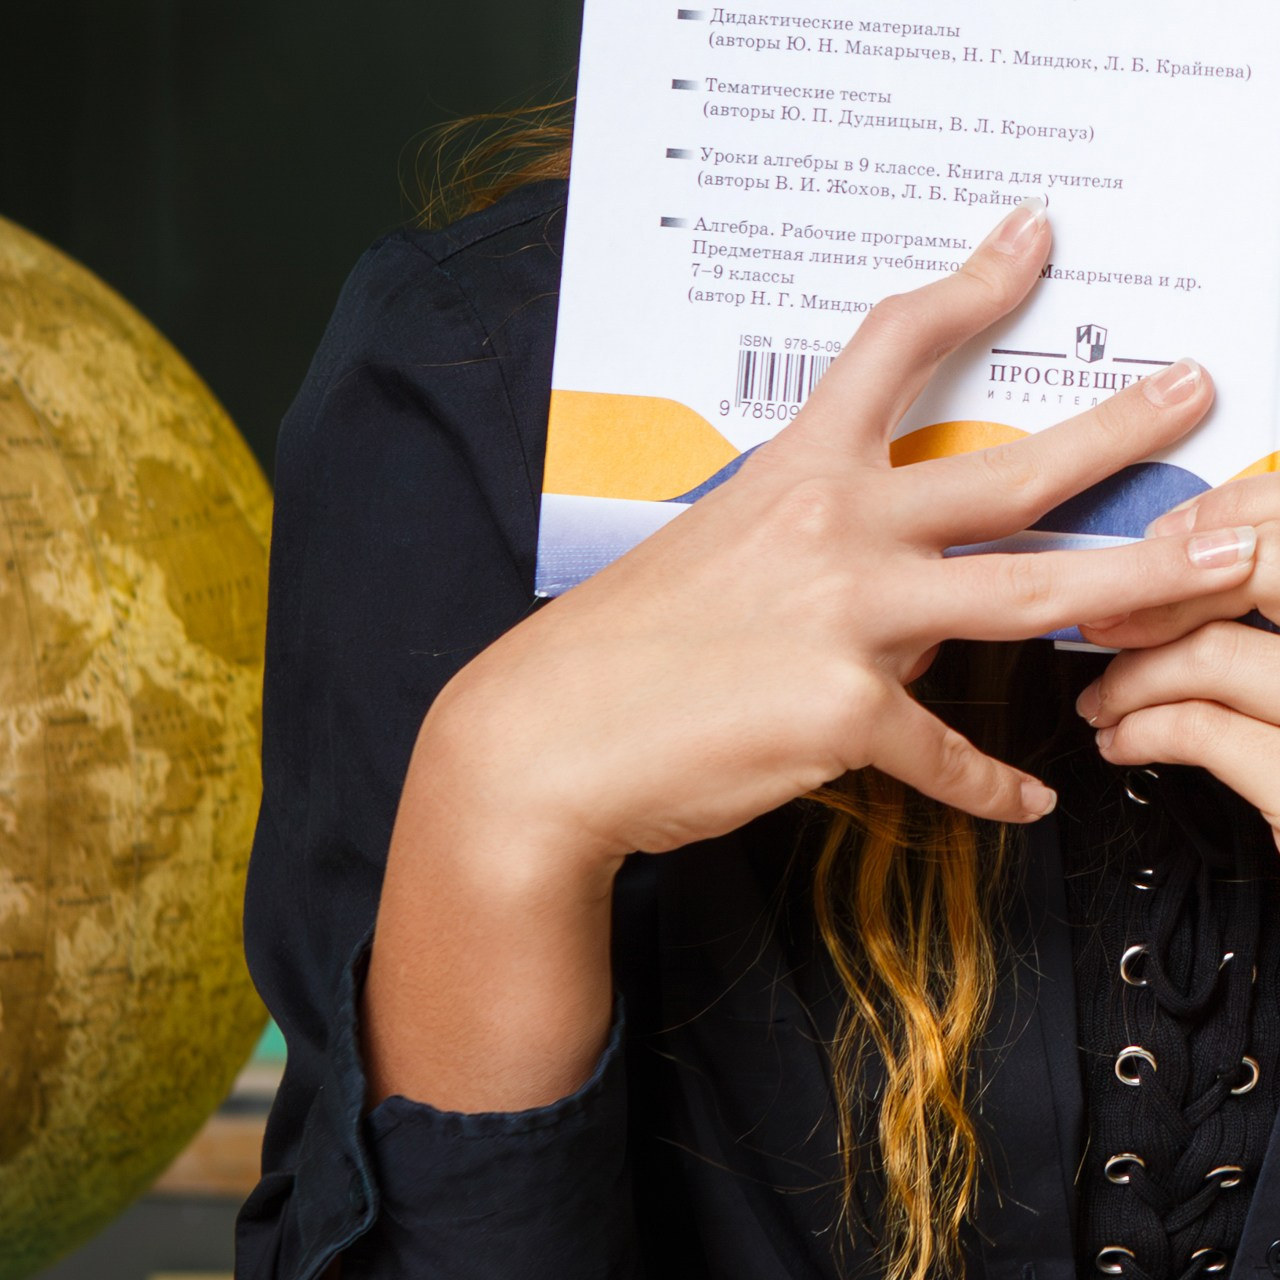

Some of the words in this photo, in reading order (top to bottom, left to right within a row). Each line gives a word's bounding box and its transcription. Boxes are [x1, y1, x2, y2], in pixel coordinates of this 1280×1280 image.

[709, 7, 854, 31] Дидактические
[858, 21, 961, 38] материалы
[708, 31, 781, 52] (авторы
[785, 35, 812, 52] Ю.
[817, 37, 839, 54] Н.
[844, 39, 957, 63] Макарычев,
[962, 46, 984, 63] Н.
[989, 48, 1007, 64] Г.
[1012, 49, 1098, 72] Миндюк,
[1103, 55, 1125, 72] Л.
[1130, 57, 1150, 73] Б.
[1156, 58, 1252, 82] Крайнева)
[704, 76, 835, 100] Тематические
[839, 90, 892, 104] тесты
[702, 100, 776, 122] (авторы
[780, 105, 806, 122] Ю.
[811, 107, 833, 124] П.
[837, 109, 943, 133] Дудницын,
[949, 116, 968, 132] В.
[973, 118, 995, 134] Л.
[1000, 119, 1095, 143] Кронгауз)
[699, 146, 759, 166] Уроки
[762, 154, 839, 173] алгебры
[843, 160, 854, 172] в
[859, 157, 870, 173] 9
[874, 162, 941, 178] классе.
[946, 163, 1004, 182] Книга
[1008, 171, 1043, 185] для
[1047, 174, 1124, 190] учителя
[697, 170, 770, 192] (авторы
[775, 175, 793, 191] В.
[799, 176, 821, 193] И.
[826, 178, 896, 200] Жохов,
[901, 183, 923, 200] Л.
[928, 185, 947, 201] Б.
[953, 187, 1049, 208] Крайне)
[692, 216, 775, 239] Алгебра.
[780, 222, 857, 242] Рабочие
[861, 231, 972, 250] программы.
[691, 239, 805, 262] Предметная
[808, 251, 868, 266] линия
[873, 255, 965, 273] учебнико
[728, 269, 795, 285] классы
[1158, 275, 1170, 287] и
[1173, 277, 1202, 292] др.
[687, 286, 746, 308] (автор
[749, 290, 771, 306] Н.
[776, 291, 794, 308] Г.
[801, 294, 873, 313] Миндю
[739, 334, 773, 348] ISBN
